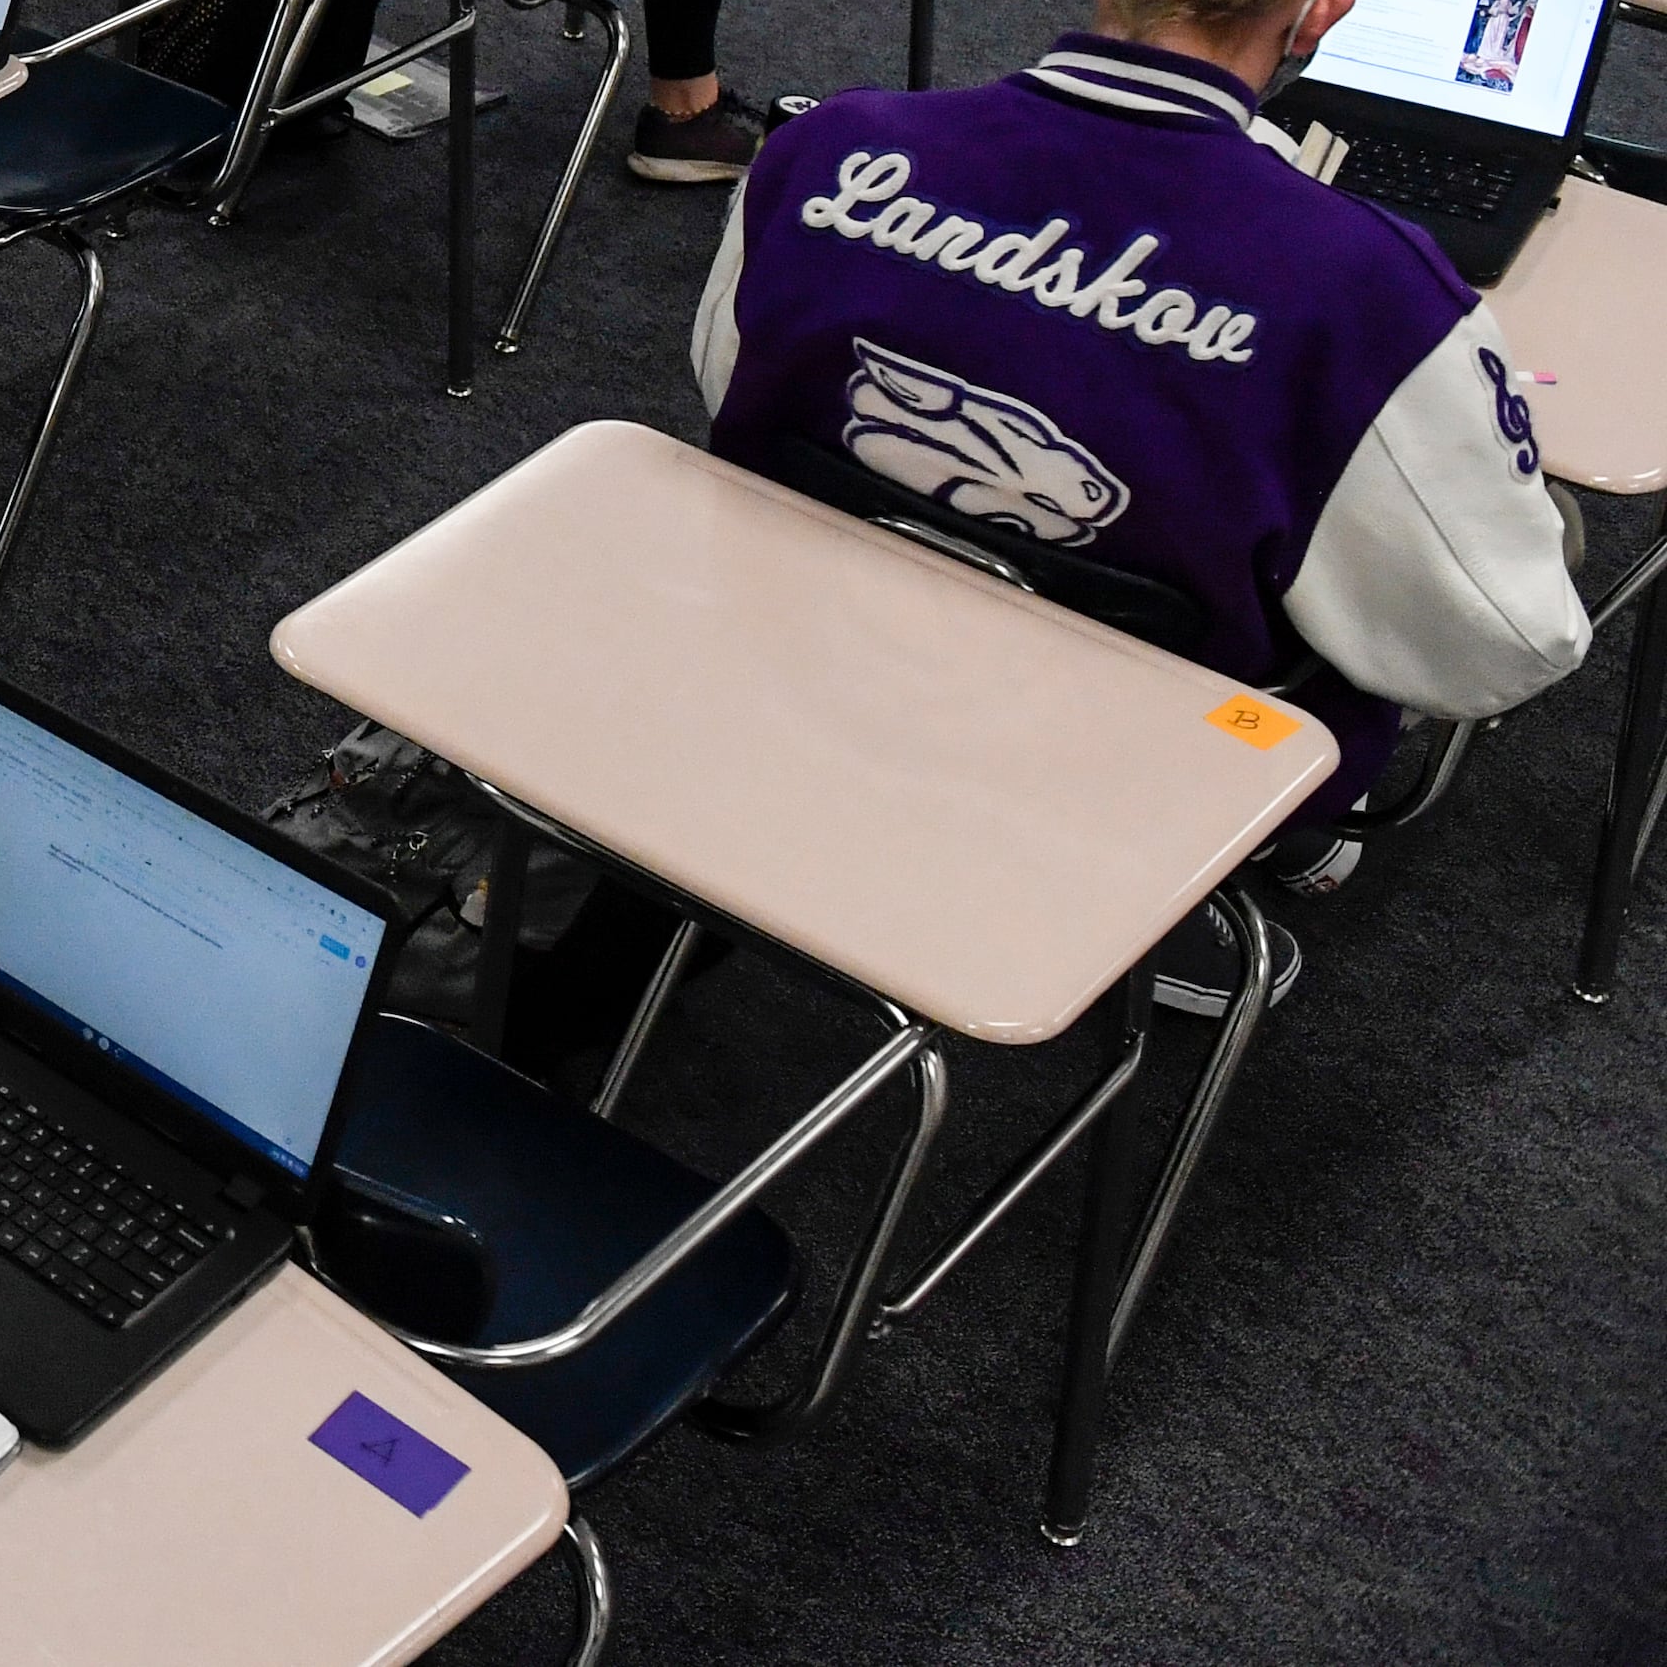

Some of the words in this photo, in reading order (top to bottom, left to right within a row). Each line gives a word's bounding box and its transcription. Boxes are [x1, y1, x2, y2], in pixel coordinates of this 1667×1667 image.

[801, 151, 1257, 363] Landskov
[1227, 709, 1260, 730] B
[361, 1437, 401, 1467] A
